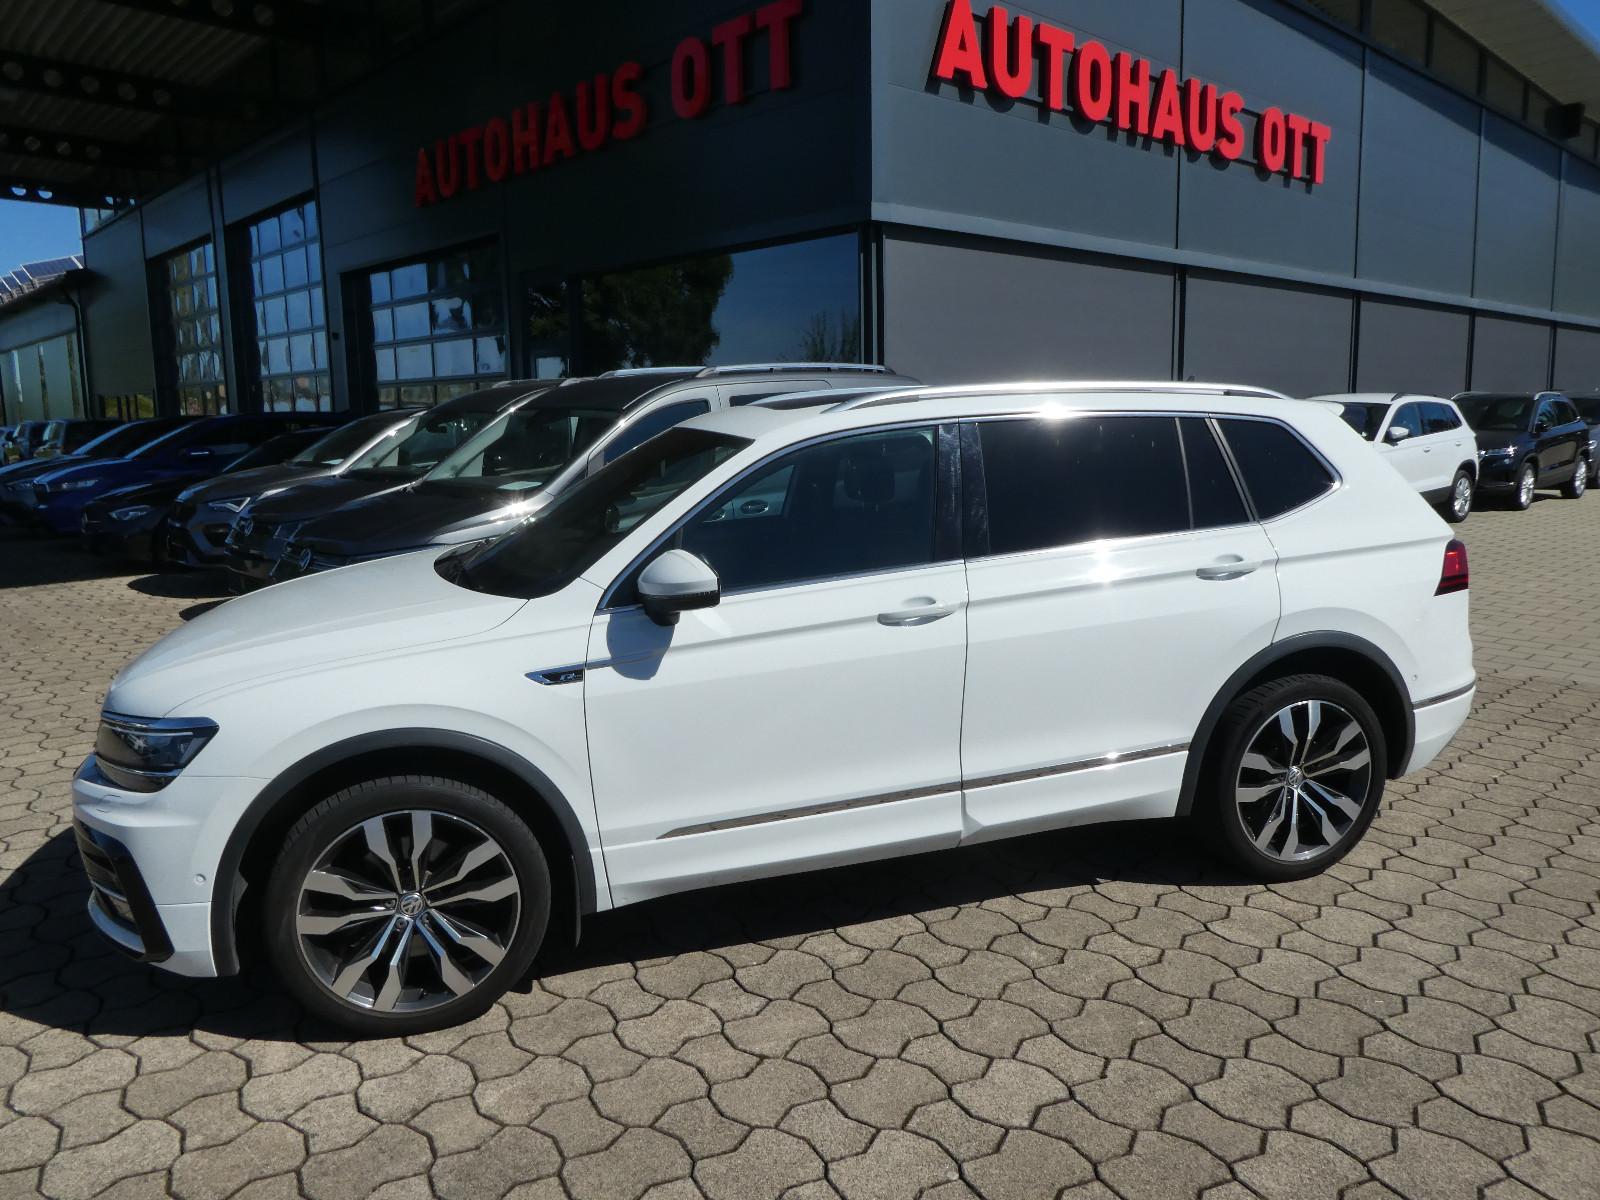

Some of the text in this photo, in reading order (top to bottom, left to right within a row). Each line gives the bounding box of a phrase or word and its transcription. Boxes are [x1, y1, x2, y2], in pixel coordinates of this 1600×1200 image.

[414, 0, 802, 207] AUTOHAUS OTT
[935, 0, 1332, 185] AUTOHAUS OTT
